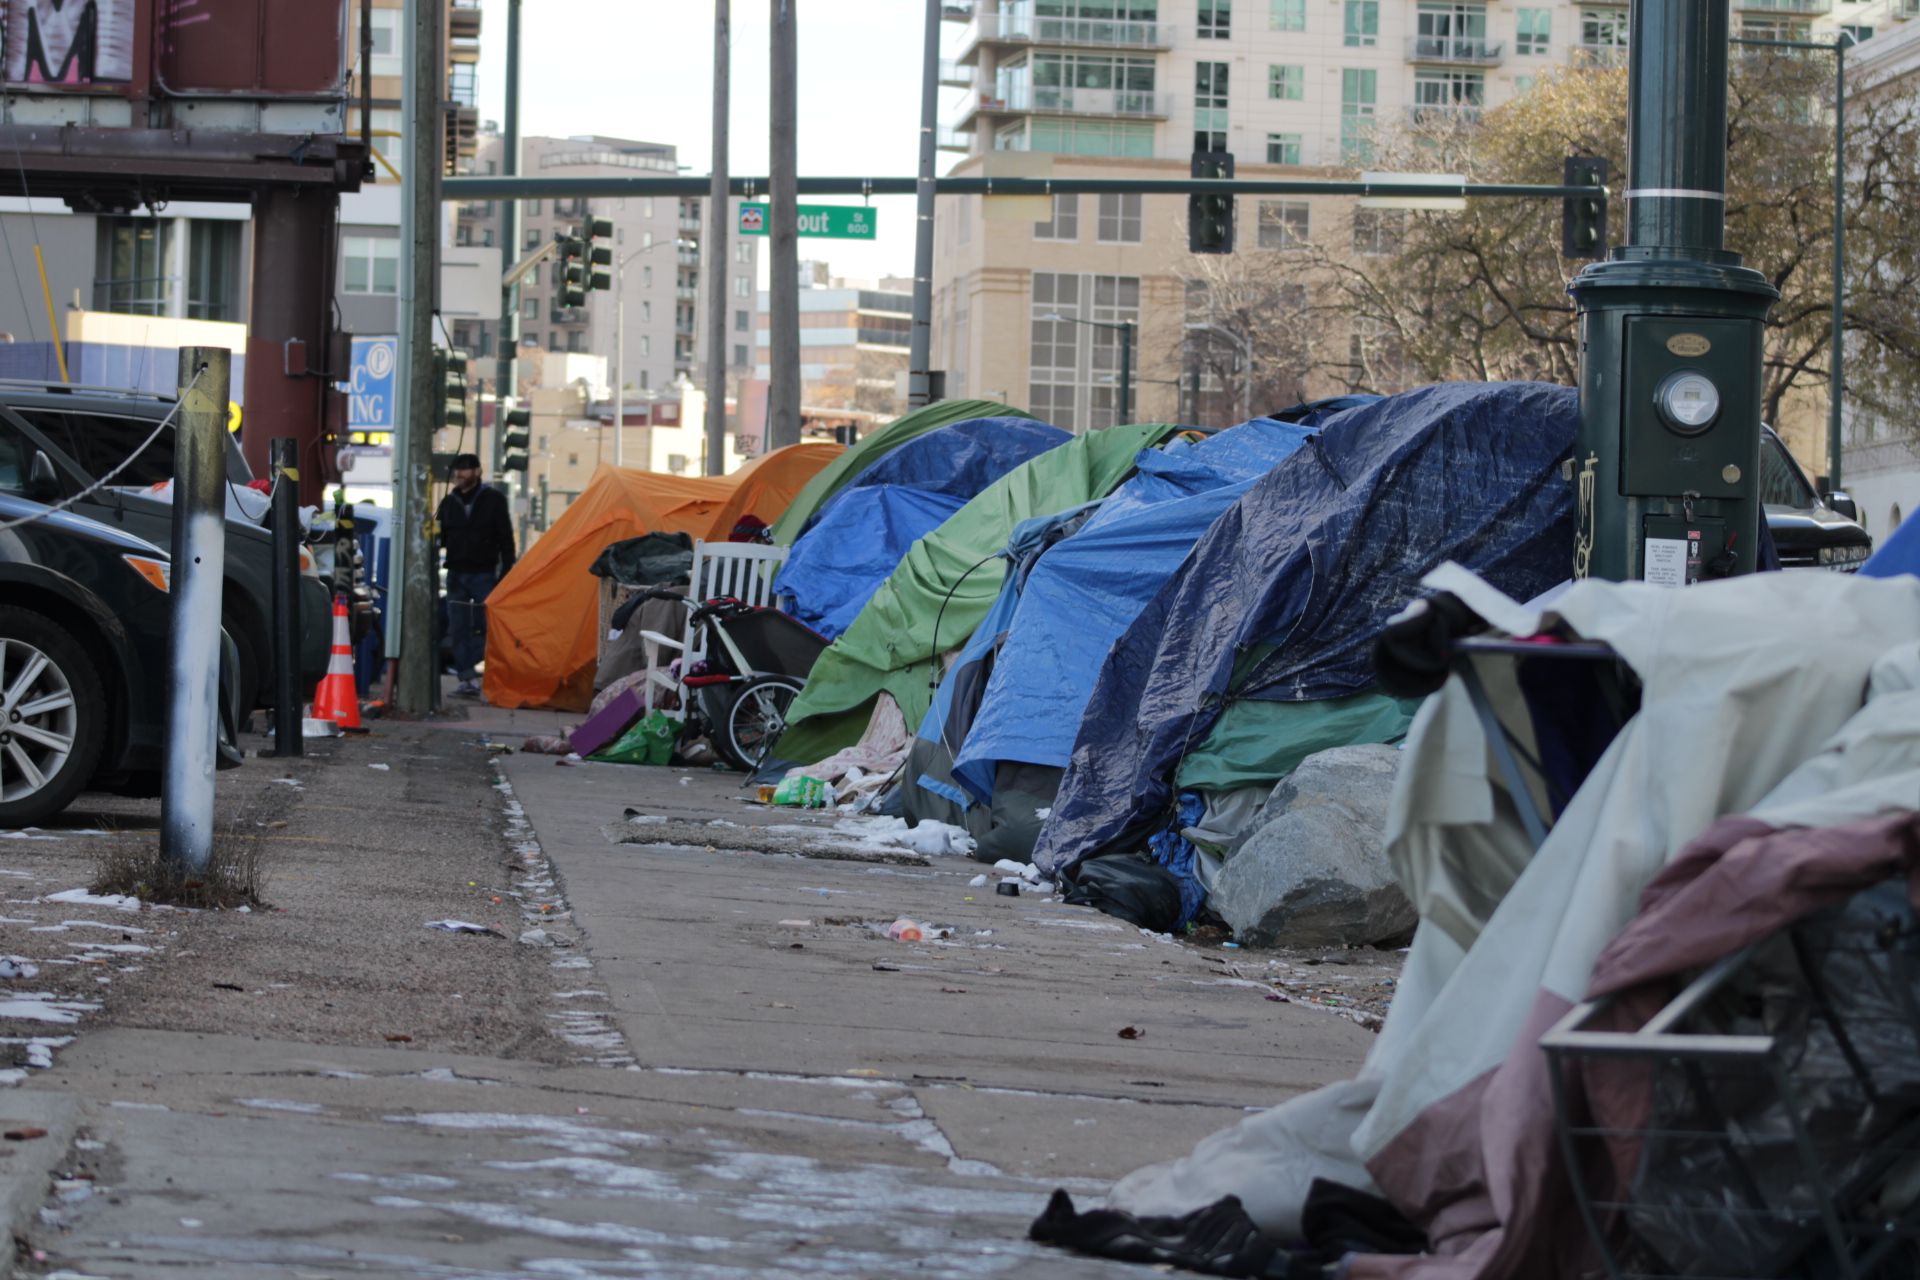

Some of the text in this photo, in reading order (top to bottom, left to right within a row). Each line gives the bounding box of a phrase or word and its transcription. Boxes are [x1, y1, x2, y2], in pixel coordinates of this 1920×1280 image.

[797, 212, 830, 233] out
[853, 213, 863, 223] St
[847, 224, 869, 234] 800
[348, 394, 384, 423] ING
